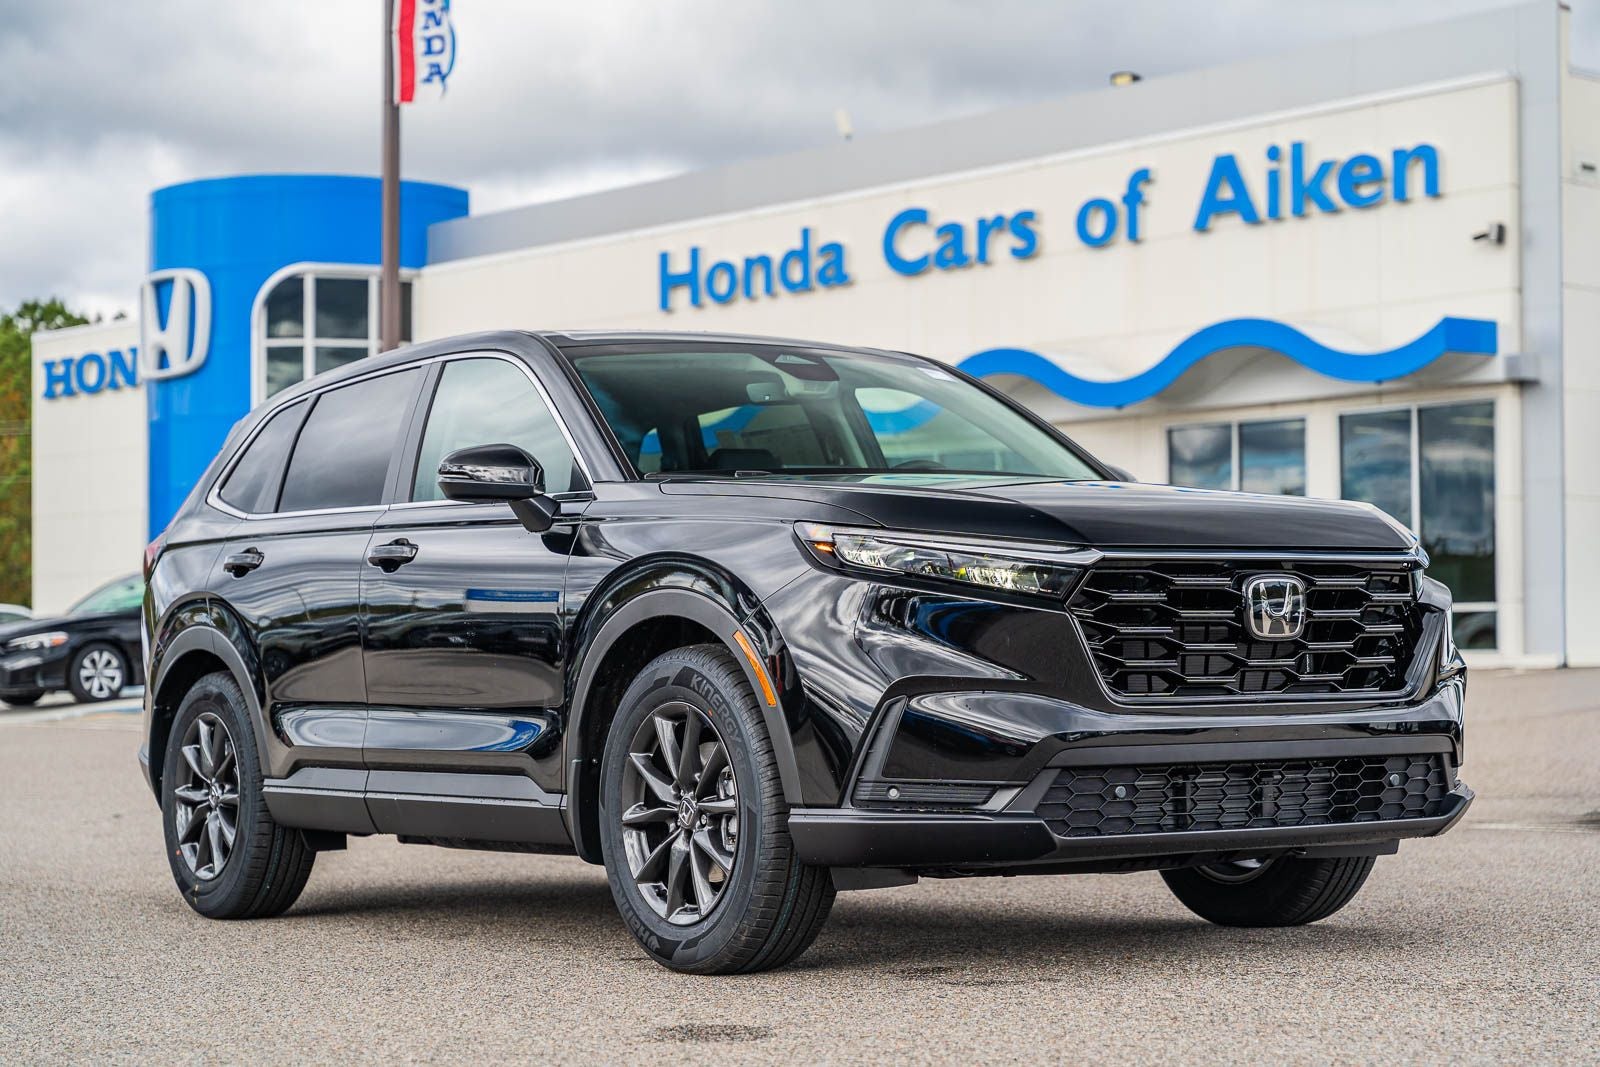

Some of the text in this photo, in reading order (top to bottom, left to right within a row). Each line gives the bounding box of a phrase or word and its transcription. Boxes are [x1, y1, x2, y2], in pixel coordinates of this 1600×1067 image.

[422, 0, 445, 83] NDA
[660, 142, 1439, 310] Honda Cars of Aiken
